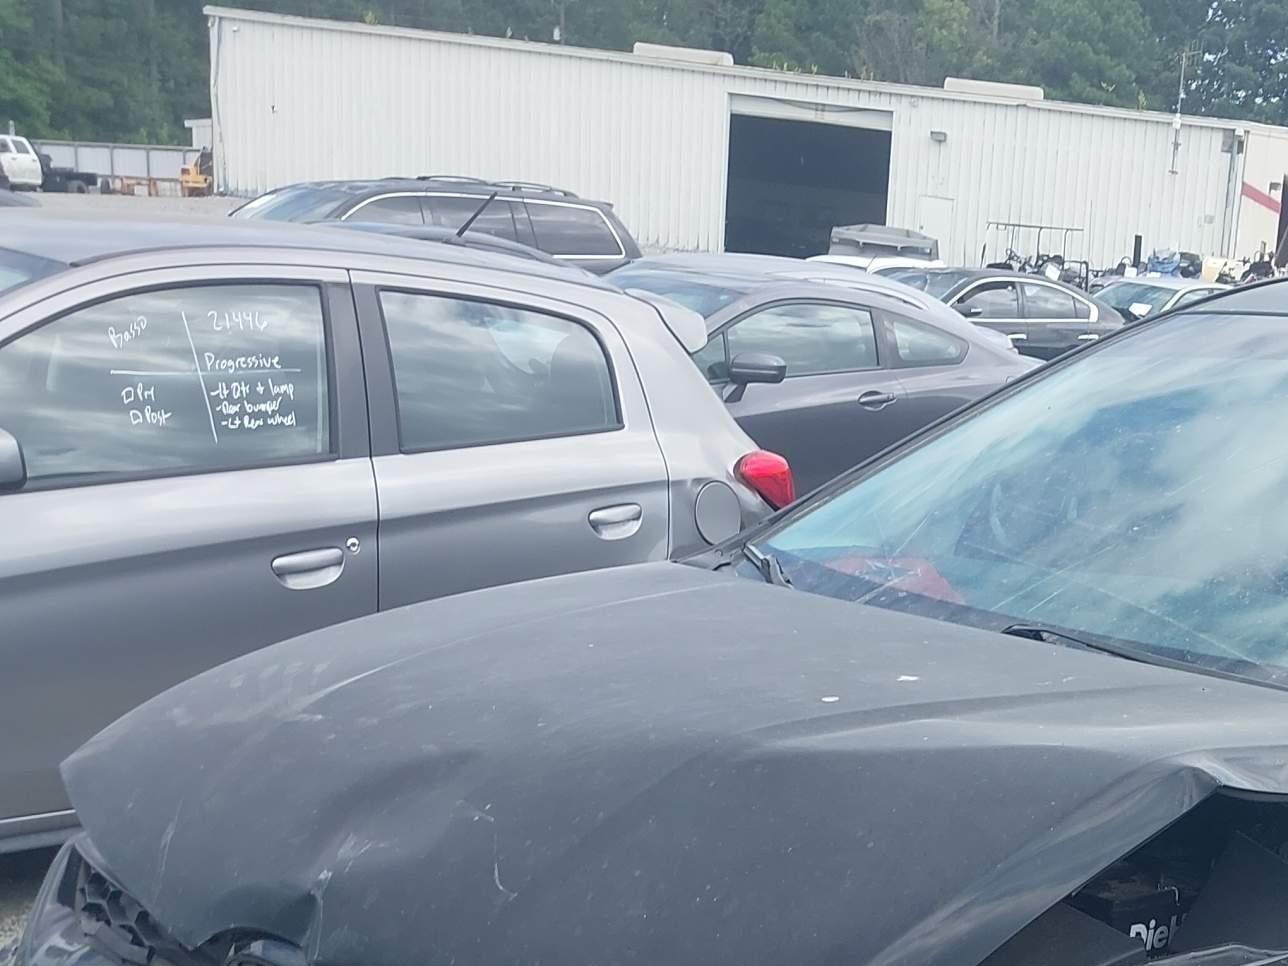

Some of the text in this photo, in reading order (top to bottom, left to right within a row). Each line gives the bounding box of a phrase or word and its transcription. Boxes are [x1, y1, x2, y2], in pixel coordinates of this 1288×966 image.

[204, 353, 282, 373] Progressive
[243, 396, 283, 415] bumper
[267, 411, 296, 427] wheel
